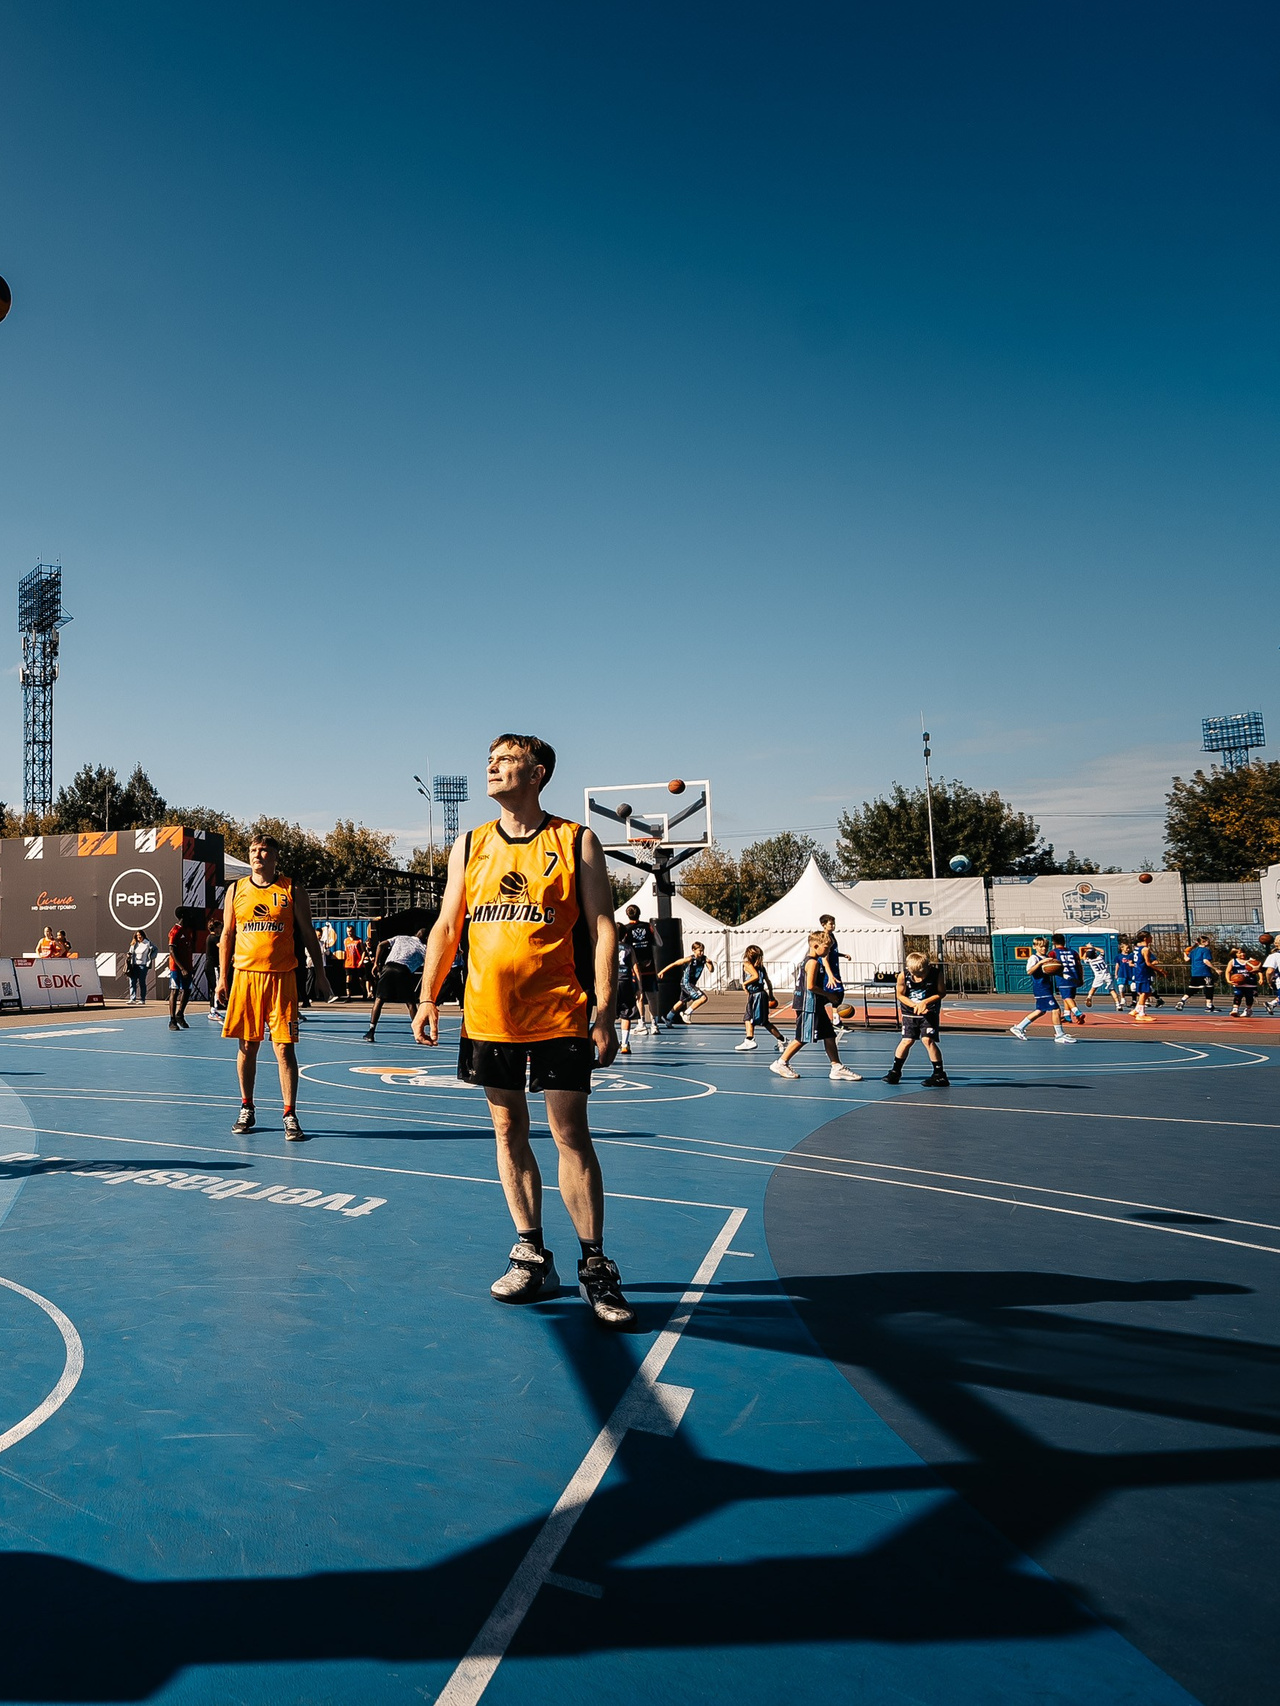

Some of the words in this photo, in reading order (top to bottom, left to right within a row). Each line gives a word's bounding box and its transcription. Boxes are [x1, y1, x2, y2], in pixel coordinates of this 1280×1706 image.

[543, 851, 559, 877] 7
[116, 892, 157, 907] РФБ
[273, 892, 288, 908] 13
[473, 904, 555, 924] ИМПУЛЬС
[891, 901, 932, 916] ВТБ
[1063, 909, 1110, 920] ТВЕРЬ
[243, 922, 285, 933] ИМПУЛЬС
[1092, 962, 1106, 973] 30
[52, 974, 82, 988] DKC
